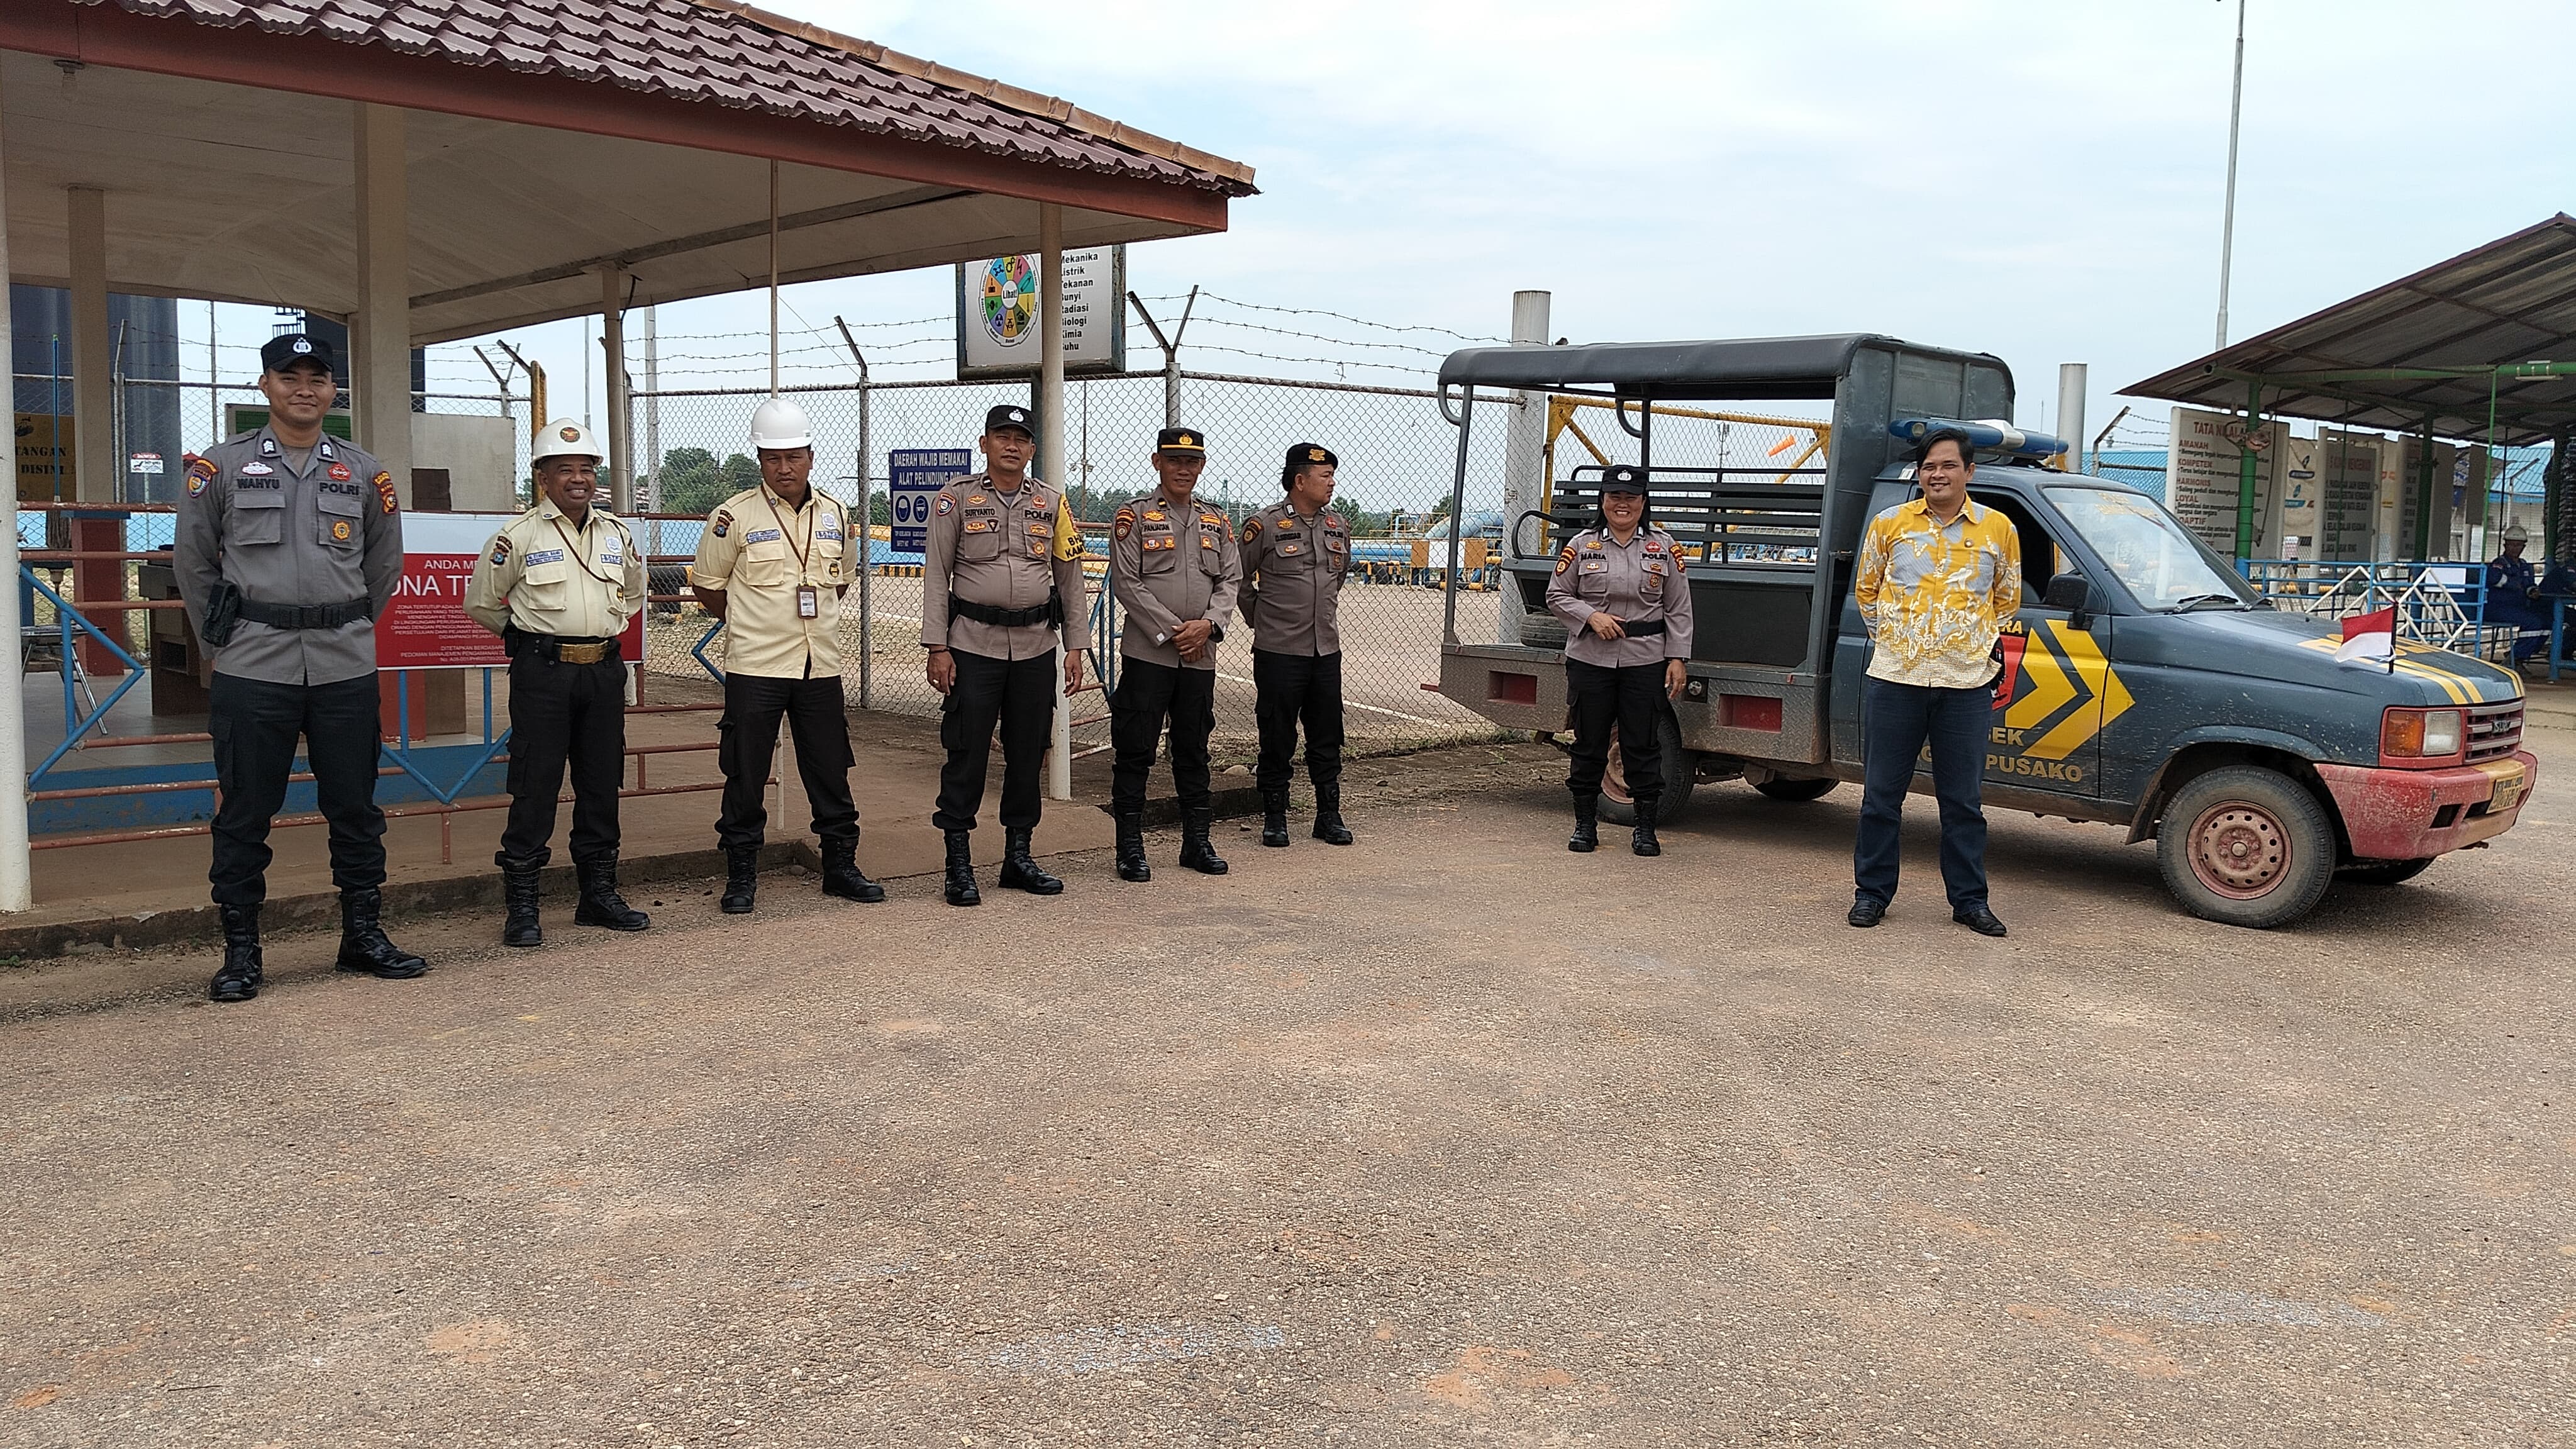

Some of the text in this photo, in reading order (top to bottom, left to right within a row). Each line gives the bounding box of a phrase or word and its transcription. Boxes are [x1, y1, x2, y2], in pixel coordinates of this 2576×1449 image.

[1062, 266, 1085, 276] istrik
[1062, 279, 1094, 289] ekanan
[1002, 289, 1018, 299] Lihat!
[1063, 342, 1079, 351] uhu
[2193, 421, 2215, 436] TATA
[894, 452, 968, 467] DAERAH WAJIB MEMAKAI
[898, 472, 913, 486] ALAT
[914, 472, 948, 486] PELINDUNG
[236, 478, 360, 496] WAHYU POLRI
[2175, 494, 2199, 503] LOYAL
[965, 508, 1053, 521] SURYANTO POLRI
[1580, 552, 1668, 561] MARIA POLRI
[424, 560, 460, 570] ANDA
[1985, 754, 2082, 782] PUSAKO
